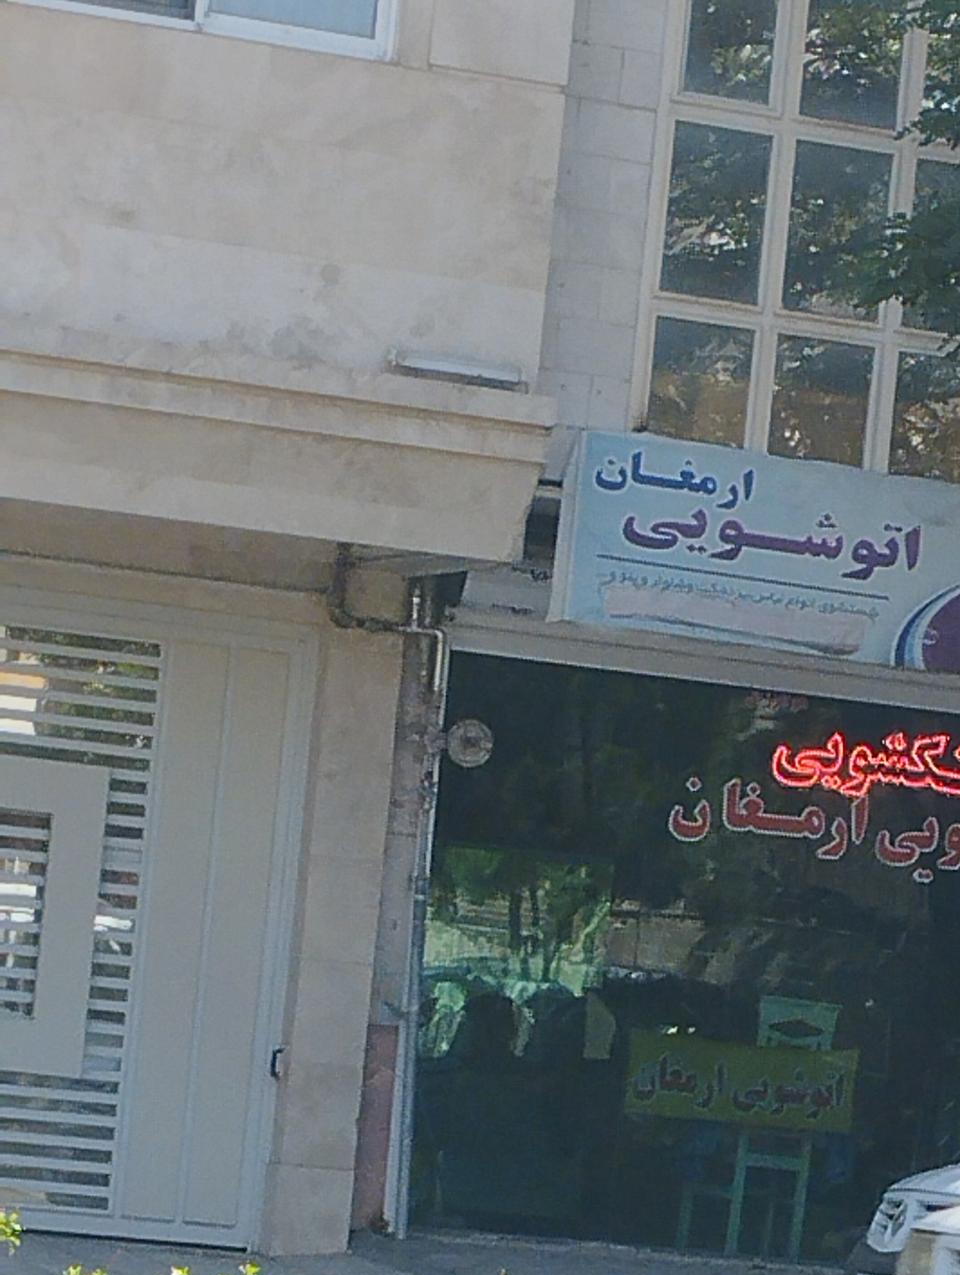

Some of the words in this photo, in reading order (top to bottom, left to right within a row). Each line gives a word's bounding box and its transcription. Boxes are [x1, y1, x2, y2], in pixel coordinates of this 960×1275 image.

[595, 450, 755, 510] ارمغان
[622, 508, 922, 580] اتوشویی
[668, 777, 869, 860] ارمغان
